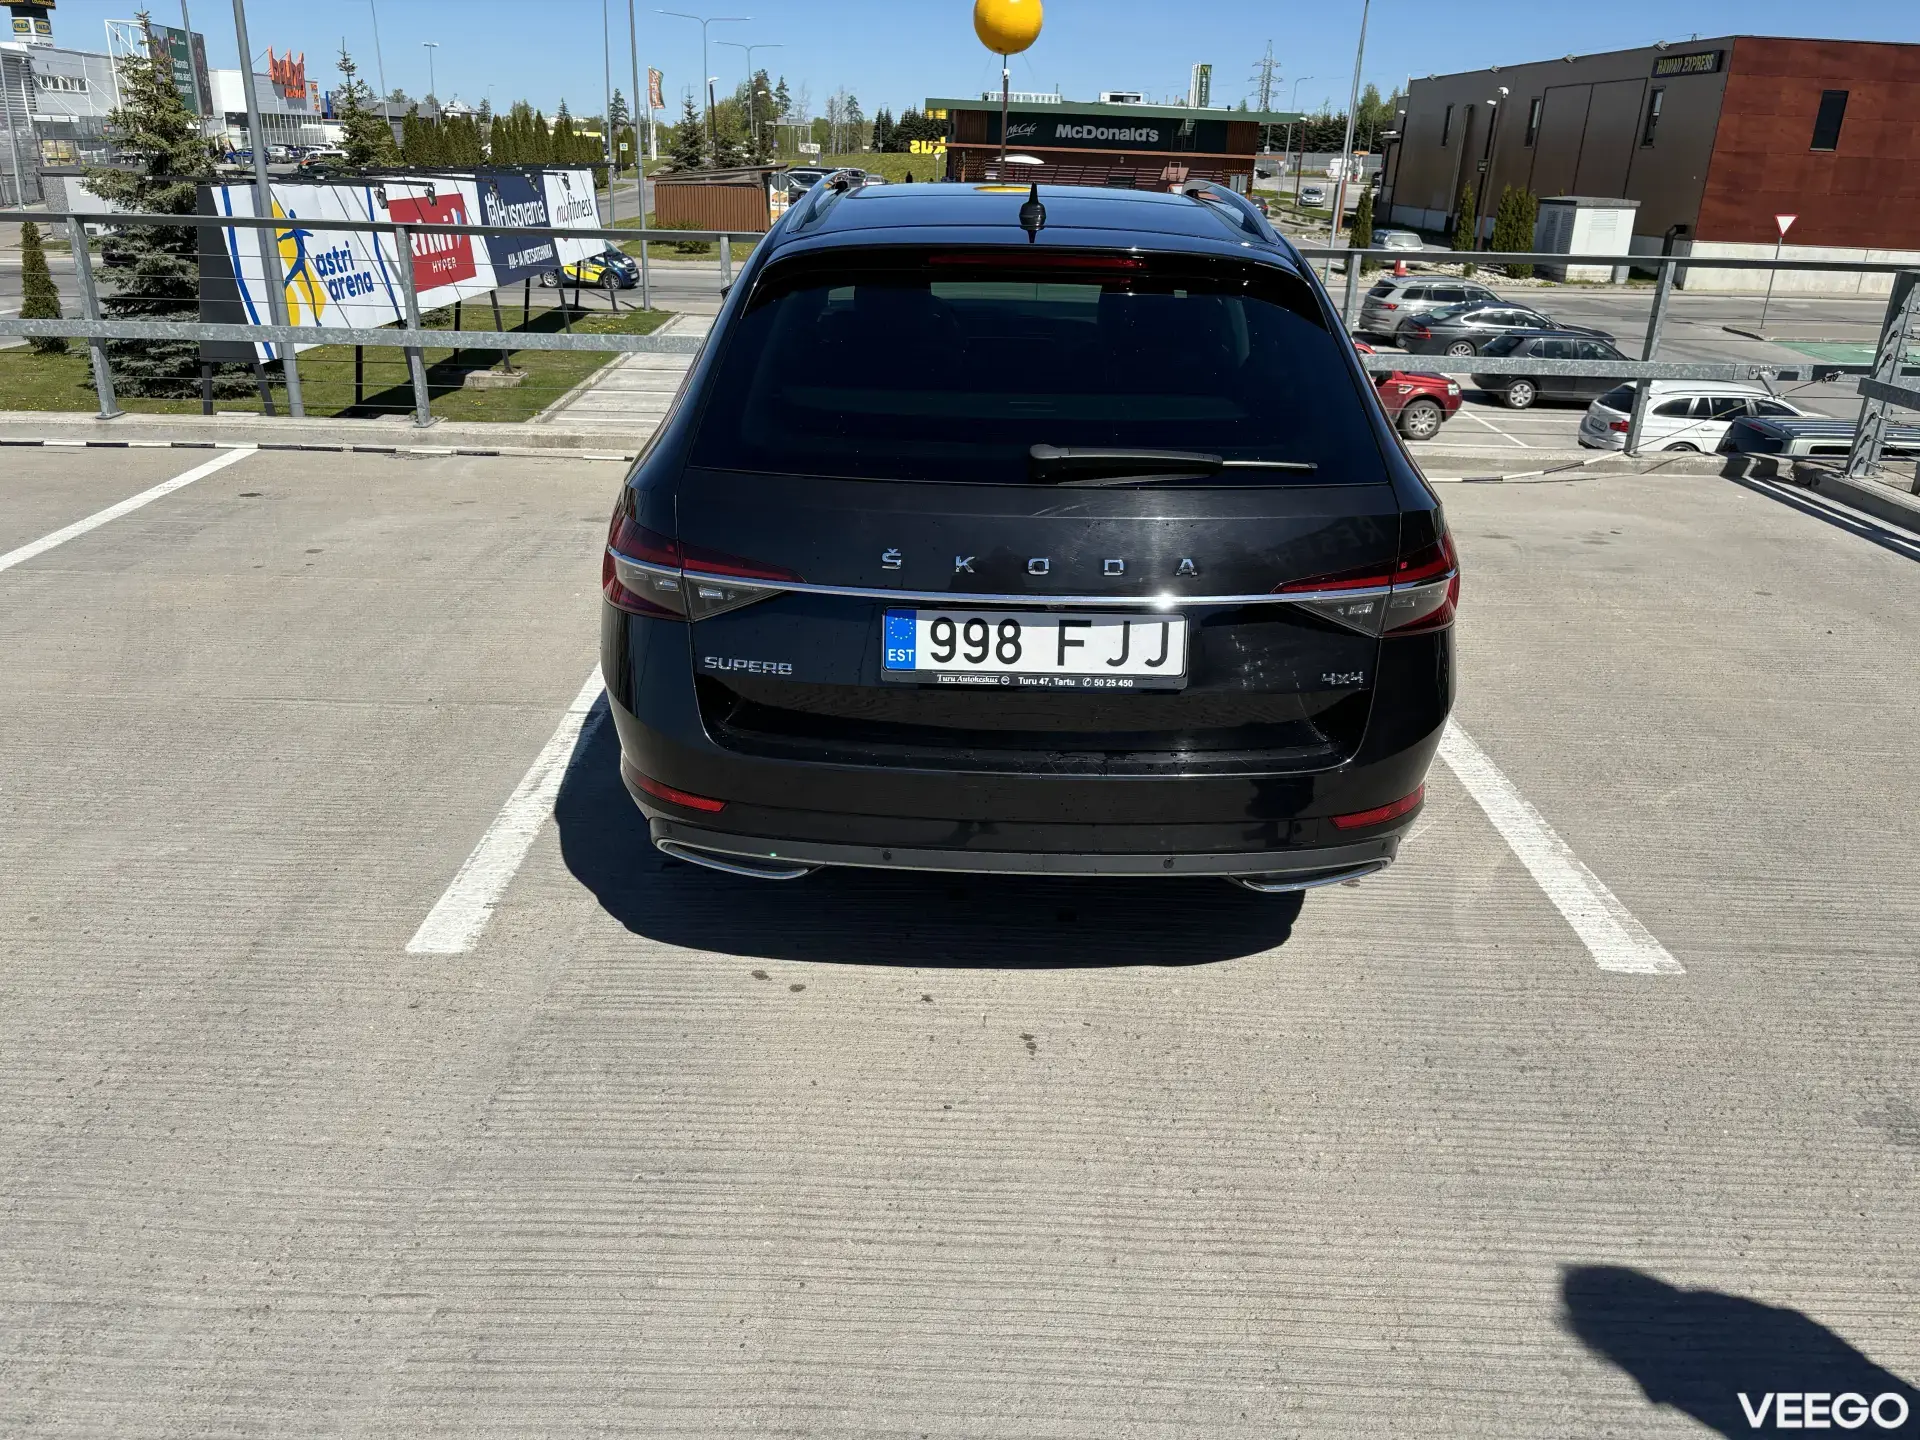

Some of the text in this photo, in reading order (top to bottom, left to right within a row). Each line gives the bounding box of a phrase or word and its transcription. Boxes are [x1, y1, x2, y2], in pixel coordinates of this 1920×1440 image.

[1681, 53, 1714, 73] EXPRESS
[1055, 123, 1160, 143] McDonald's
[315, 240, 355, 277] astri
[431, 256, 457, 273] HYPER
[328, 270, 375, 301] arena
[881, 548, 1198, 576] ŠKODA
[930, 616, 1170, 668] 998 FJJ
[887, 648, 915, 662] EST
[704, 656, 792, 675] SUPERB
[936, 674, 957, 683] Turu
[1018, 677, 1038, 686] Turu
[1039, 677, 1052, 687] 47,
[1054, 678, 1076, 686] Tartu
[1094, 678, 1105, 687] 50
[1106, 679, 1117, 687] 25
[1118, 679, 1134, 688] 450
